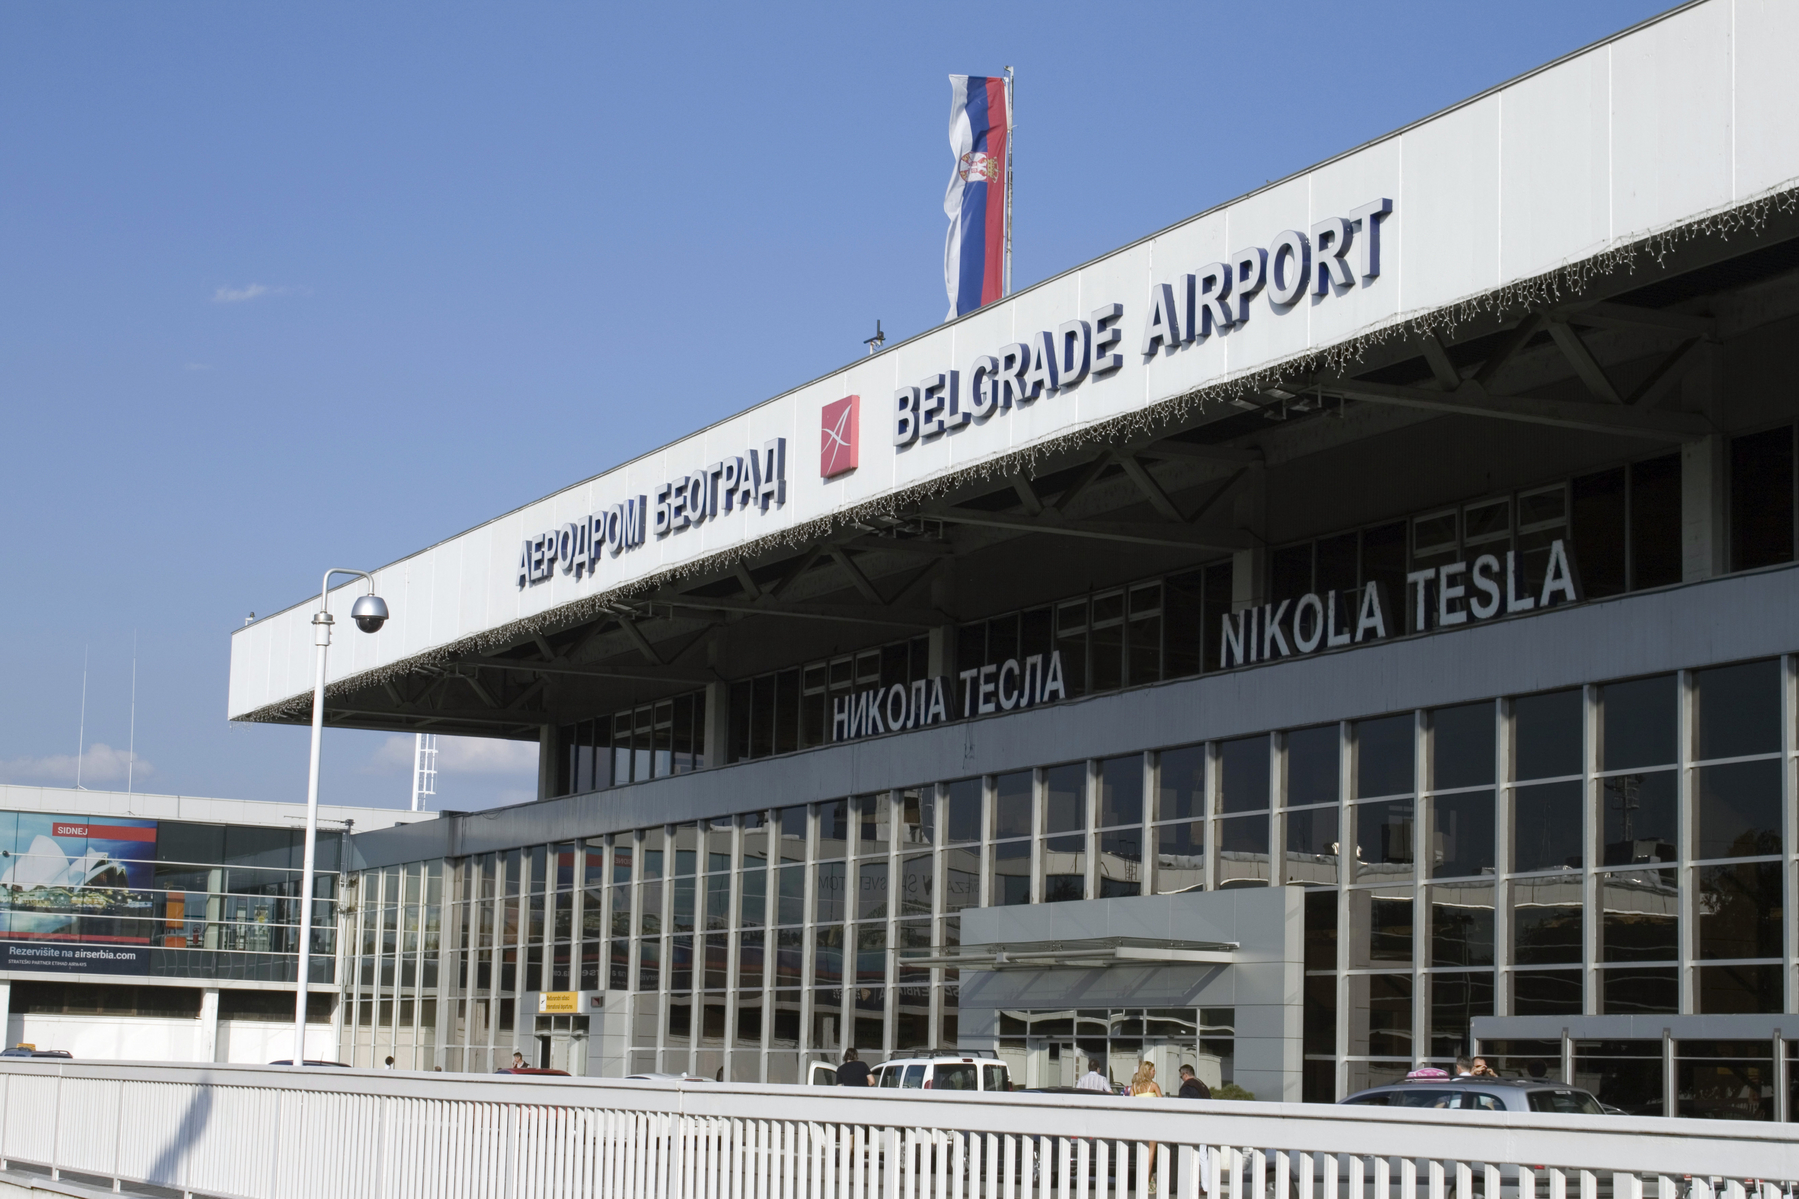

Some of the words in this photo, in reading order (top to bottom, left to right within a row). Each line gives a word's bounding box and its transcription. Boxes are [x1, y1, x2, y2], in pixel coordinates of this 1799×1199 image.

[893, 302, 1124, 448] BELGRADE
[1141, 197, 1393, 357] AIRPORT
[515, 494, 647, 587] АЕРОДРОМ
[653, 437, 787, 537] БЕОГРАД
[1219, 579, 1388, 669] NIKOLA
[1406, 538, 1579, 632] TESLA
[832, 675, 948, 742] НИКОЛА
[959, 649, 1067, 718] ТЕСЛА
[57, 826, 88, 836] SIDNEJ
[9, 946, 60, 958] Rezervišite
[75, 949, 136, 961] airserbia.com
